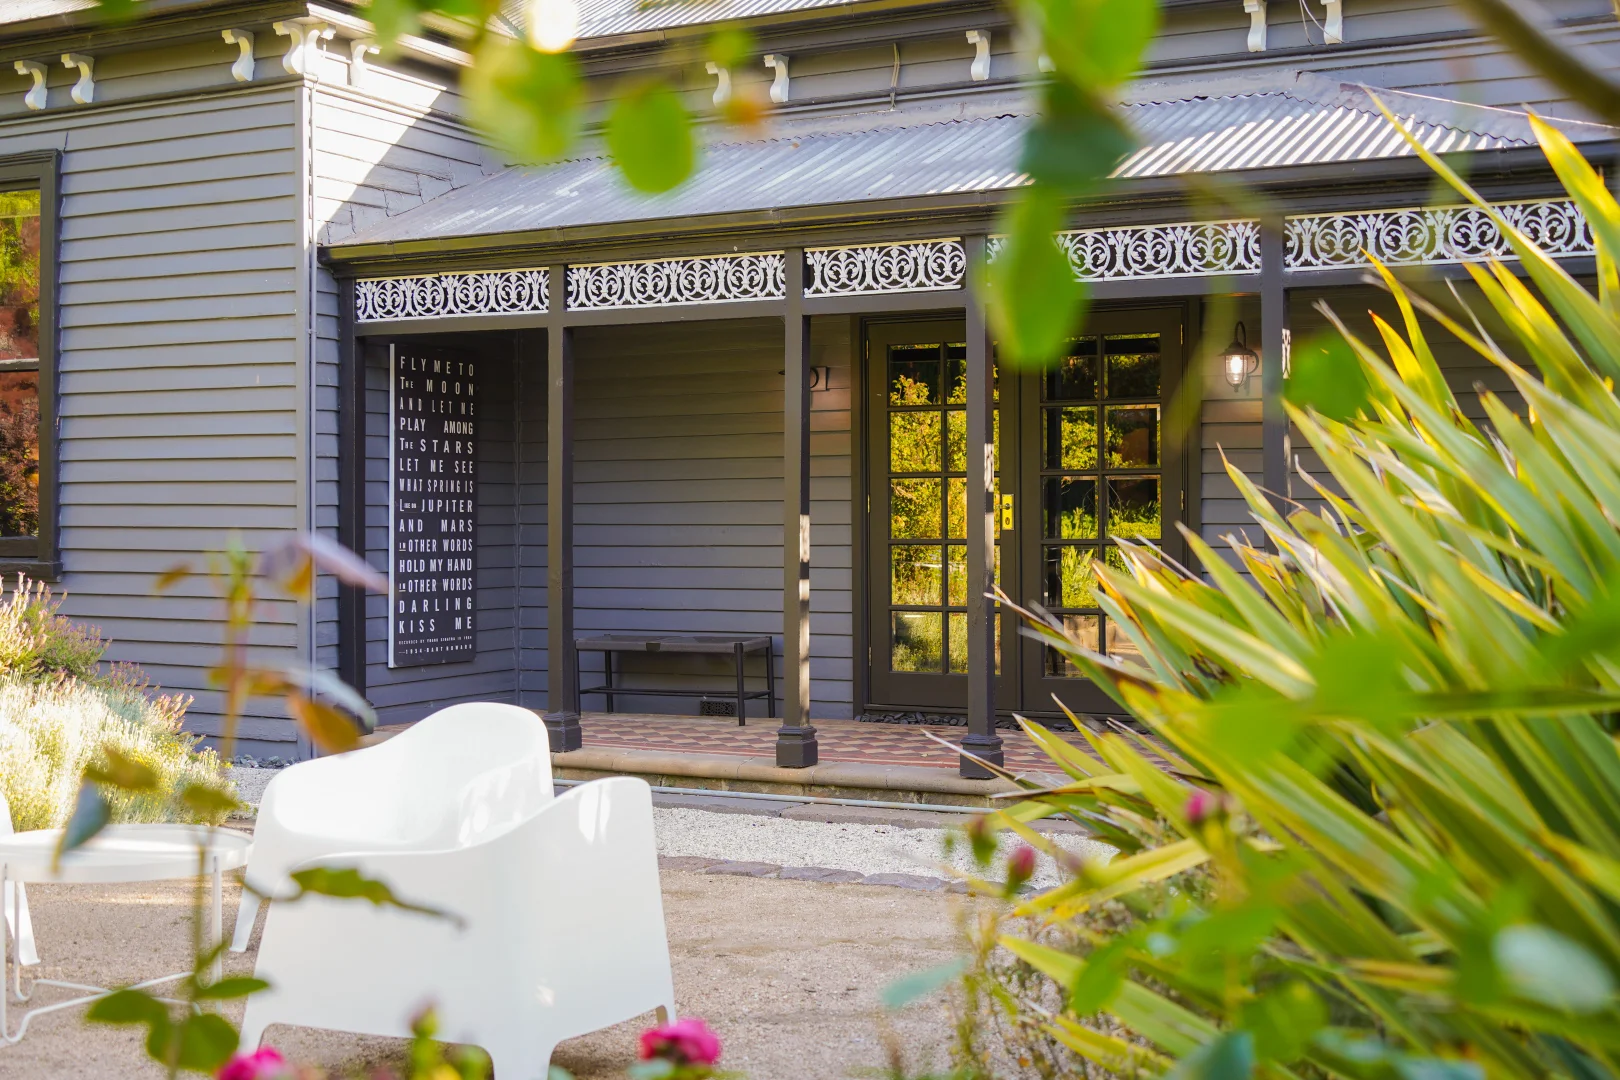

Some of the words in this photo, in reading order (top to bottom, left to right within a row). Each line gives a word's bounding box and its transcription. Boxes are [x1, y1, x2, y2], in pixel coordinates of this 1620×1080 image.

[400, 356, 426, 371] FLY
[434, 360, 451, 374] ME
[459, 362, 474, 376] TO
[426, 379, 474, 396] MOON
[400, 396, 422, 412] AND
[432, 400, 452, 414] LET
[461, 402, 474, 416] ME
[400, 416, 426, 432] PLAY
[444, 420, 474, 434] AMONG
[420, 438, 473, 454] STARS
[400, 458, 418, 472] LET
[430, 460, 444, 472] ME
[454, 460, 473, 474] SEE
[400, 478, 422, 492] WHAT
[428, 479, 460, 492] SPRING
[464, 480, 474, 493] IS
[421, 498, 472, 512] JUPITER
[399, 518, 423, 532] AND
[441, 519, 472, 532] MARS
[408, 538, 437, 552] OTHER
[442, 538, 472, 552] WORDS
[400, 560, 425, 572] HOLD
[430, 558, 443, 572] MY
[448, 558, 472, 572] HAND
[408, 578, 436, 592] OTHER
[442, 578, 472, 592] WORDS
[400, 596, 472, 614] DARLING
[399, 618, 435, 634] KISS
[455, 616, 472, 630] ME
